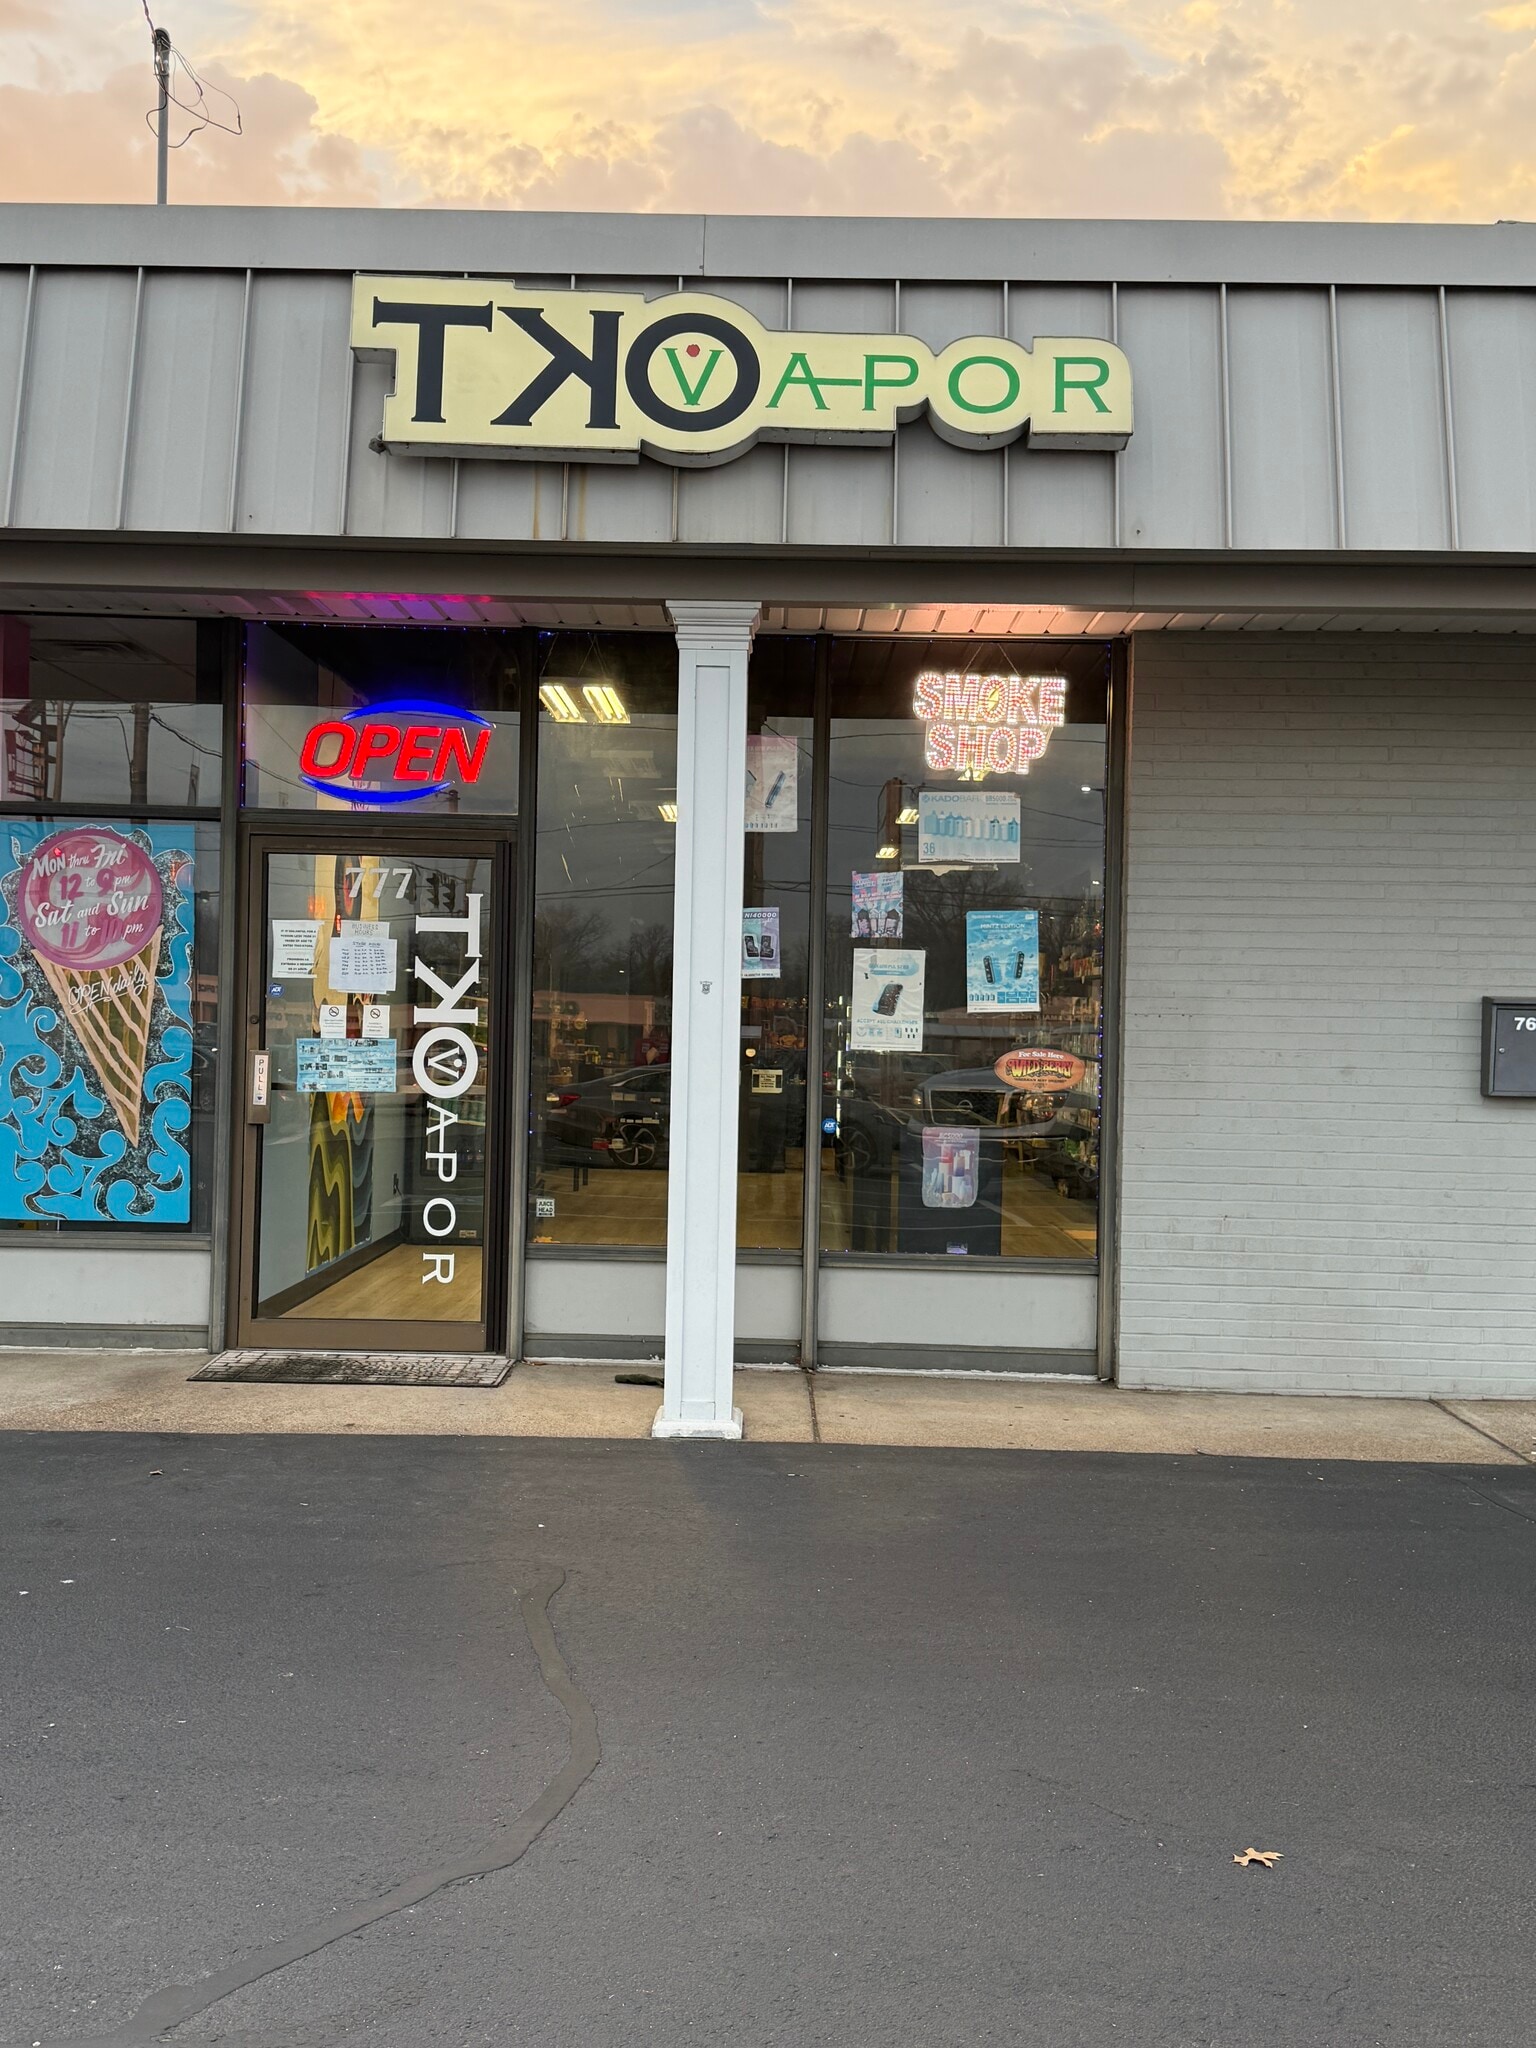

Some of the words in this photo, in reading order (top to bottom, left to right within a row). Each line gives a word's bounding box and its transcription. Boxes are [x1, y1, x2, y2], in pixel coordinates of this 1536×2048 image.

[914, 671, 1067, 727] SMOKE
[300, 720, 492, 784] OPEN
[925, 723, 1048, 775] SHOP
[67, 852, 90, 869] thru
[90, 842, 127, 870] Fri
[922, 842, 936, 855] 36
[58, 873, 84, 902] 12
[84, 875, 96, 887] to
[96, 868, 115, 897] 9
[114, 874, 132, 891] pm
[345, 867, 413, 899] 777
[35, 901, 75, 928] Sat
[77, 902, 101, 919] and
[106, 890, 150, 916] Sun
[60, 920, 80, 949] 11
[84, 923, 101, 937] to
[123, 921, 145, 940] pm
[68, 977, 112, 1006] OPEN
[111, 964, 150, 996] daily
[1006, 1059, 1040, 1078] WILD
[1047, 1052, 1065, 1060] Here
